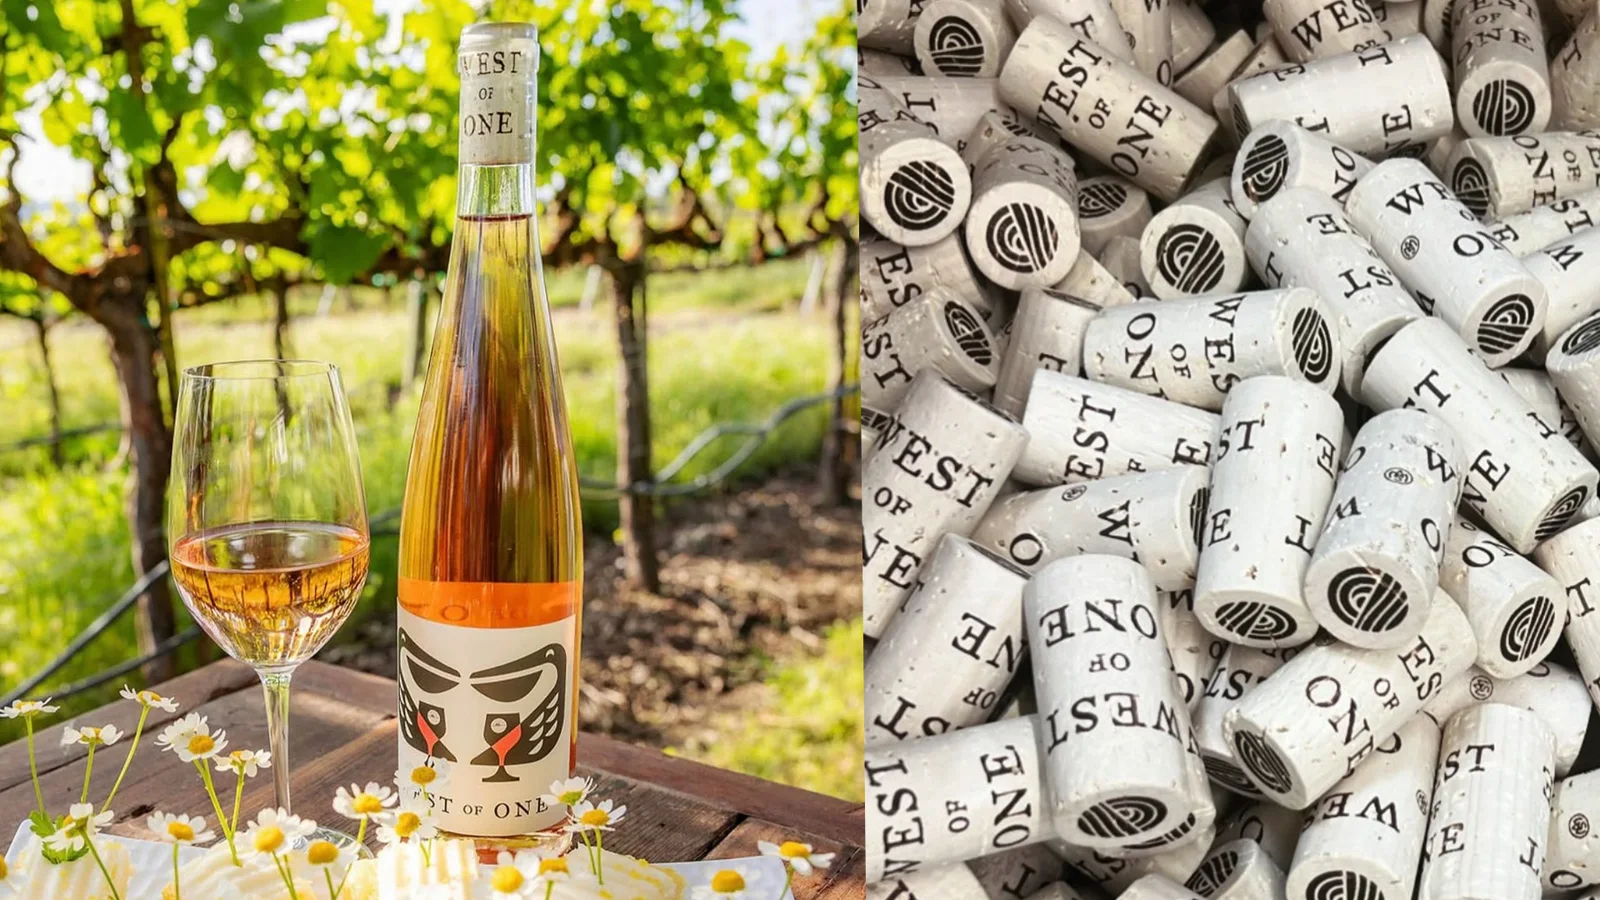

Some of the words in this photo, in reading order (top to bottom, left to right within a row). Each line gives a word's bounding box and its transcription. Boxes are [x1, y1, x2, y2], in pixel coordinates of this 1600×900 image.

[1290, 0, 1373, 53] WES
[1475, 12, 1501, 25] OF
[1457, 28, 1534, 66] ONE
[478, 87, 494, 100] OF
[1036, 40, 1102, 132] WEST
[464, 112, 513, 136] ONE
[1088, 97, 1113, 130] OF
[1111, 95, 1172, 178] ONE
[1331, 146, 1358, 212] ON
[1512, 135, 1557, 208] ONE
[1563, 150, 1582, 182] OF
[1550, 199, 1594, 234] ST
[875, 246, 922, 307] ES
[862, 313, 913, 389] EST
[1170, 343, 1192, 379] OF
[1208, 294, 1247, 394] WES
[1064, 394, 1116, 480] EST
[1217, 420, 1260, 462] ST
[874, 487, 913, 516] OF
[1461, 449, 1511, 517] NE
[862, 528, 922, 590] NE
[951, 612, 1029, 673] NE
[1039, 598, 1158, 648] ONE
[1088, 652, 1131, 673] OF
[962, 687, 997, 710] OF
[1373, 677, 1400, 710] OF
[1047, 692, 1183, 755] WEST
[1443, 743, 1495, 782] ST
[413, 788, 453, 813] ST
[462, 804, 484, 815] OF
[494, 797, 549, 819] ONE
[946, 800, 970, 833] OF
[980, 744, 1032, 848] ONE
[864, 758, 925, 882] WEST
